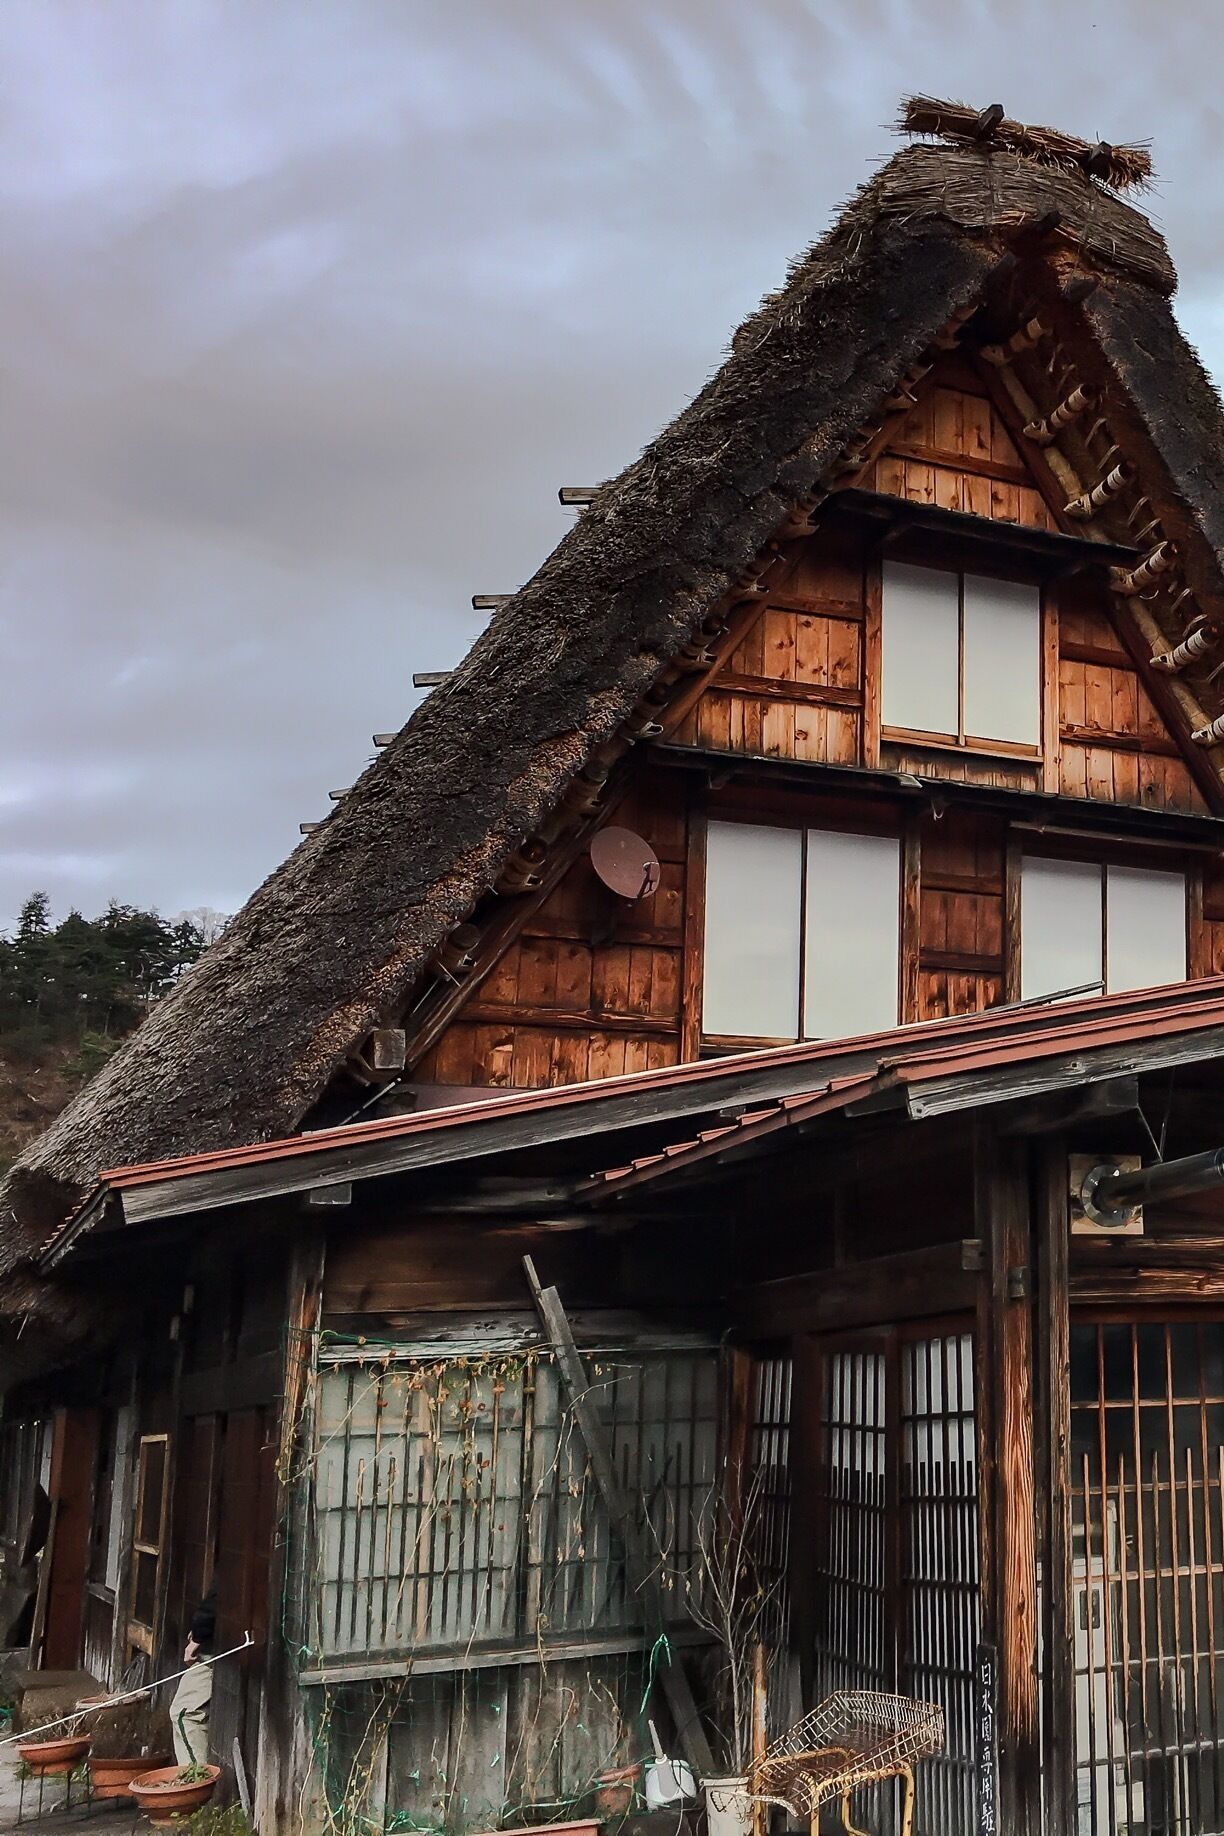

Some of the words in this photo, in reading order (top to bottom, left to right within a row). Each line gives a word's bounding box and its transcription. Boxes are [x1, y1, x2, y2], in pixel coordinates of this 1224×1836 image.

[980, 1657, 995, 1836] 白水園専用駐
